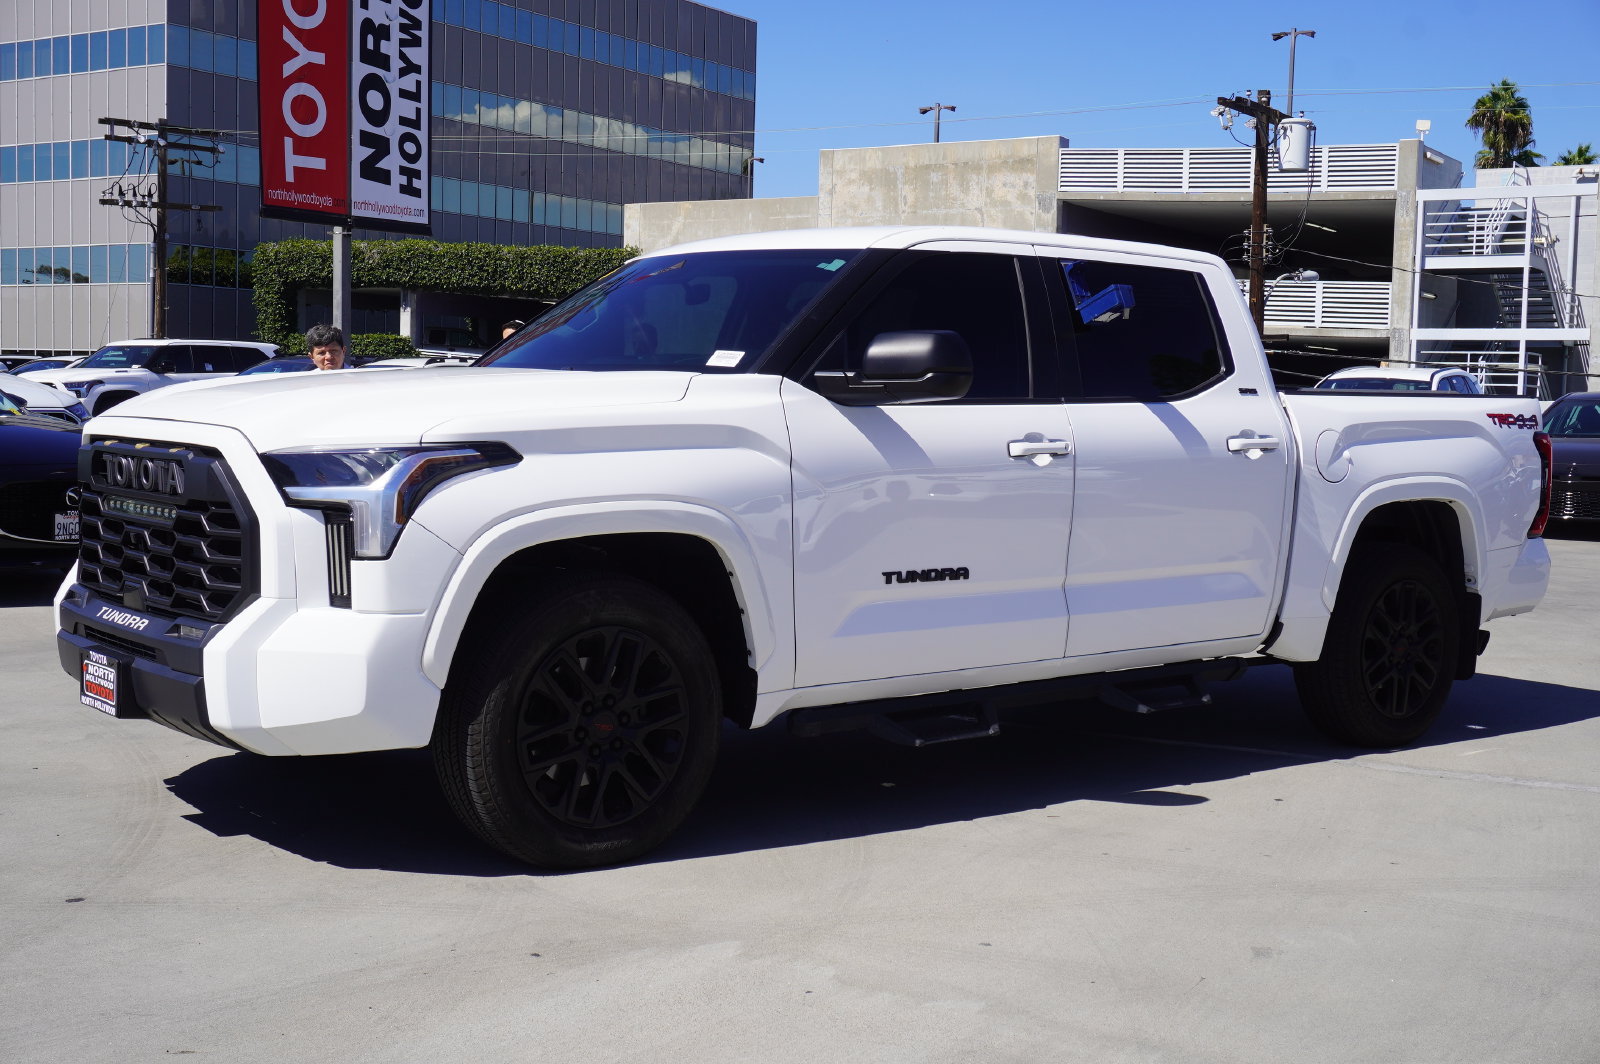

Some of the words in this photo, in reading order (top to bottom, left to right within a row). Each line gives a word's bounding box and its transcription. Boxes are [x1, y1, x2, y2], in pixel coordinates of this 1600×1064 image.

[398, 0, 422, 199] HOLLYW
[353, 200, 425, 217] northhollywoodtoyota.com
[102, 453, 184, 494] TOYOTA
[881, 566, 970, 585] TUNDRA
[95, 606, 150, 631] TUNDRA
[90, 650, 108, 666] TOYOTA
[85, 673, 114, 690] HOLLYWOOD
[88, 663, 114, 682] NORTH
[85, 680, 114, 702] TOYOTA
[81, 694, 95, 707] NORTH
[94, 699, 116, 716] HOLLYWOOD
